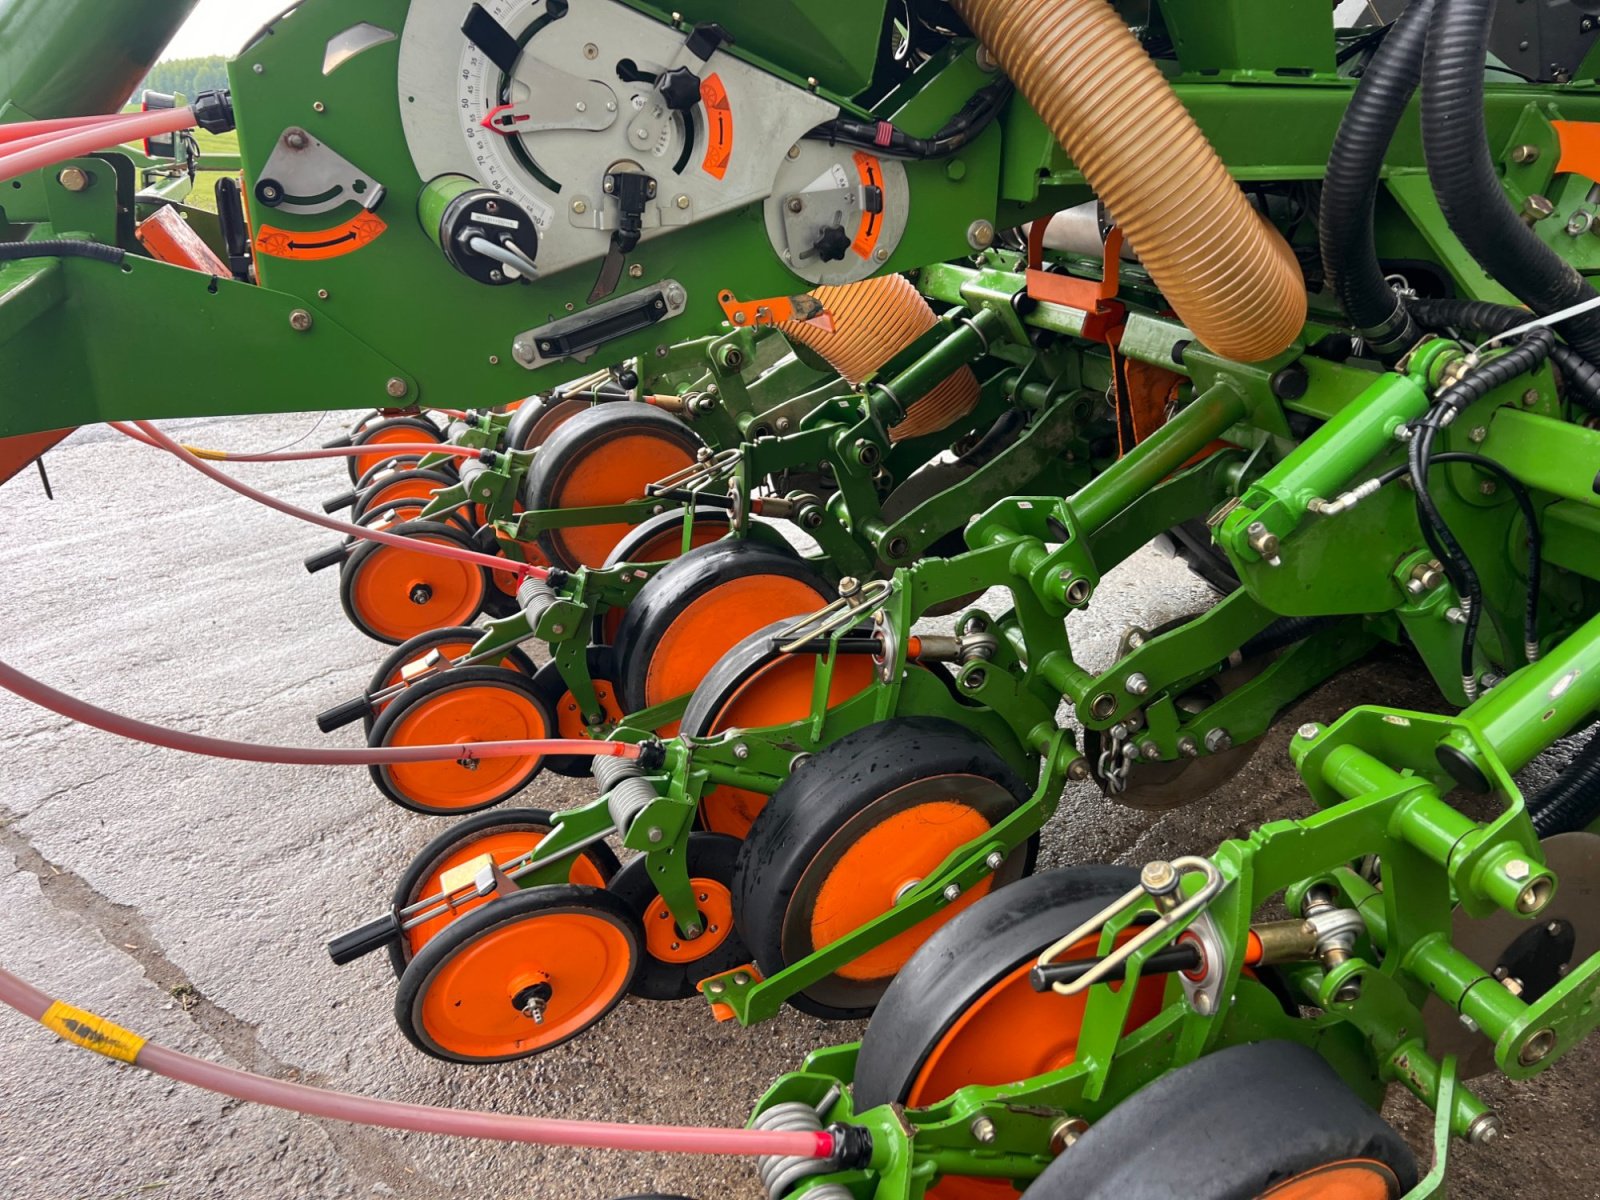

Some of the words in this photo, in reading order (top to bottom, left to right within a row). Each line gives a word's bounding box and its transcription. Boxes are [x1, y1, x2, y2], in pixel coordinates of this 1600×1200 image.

[462, 69, 470, 80] 40
[467, 85, 474, 94] 45
[461, 98, 469, 109] 50
[467, 127, 475, 138] 60
[477, 155, 486, 166] 70
[492, 179, 502, 190] 80
